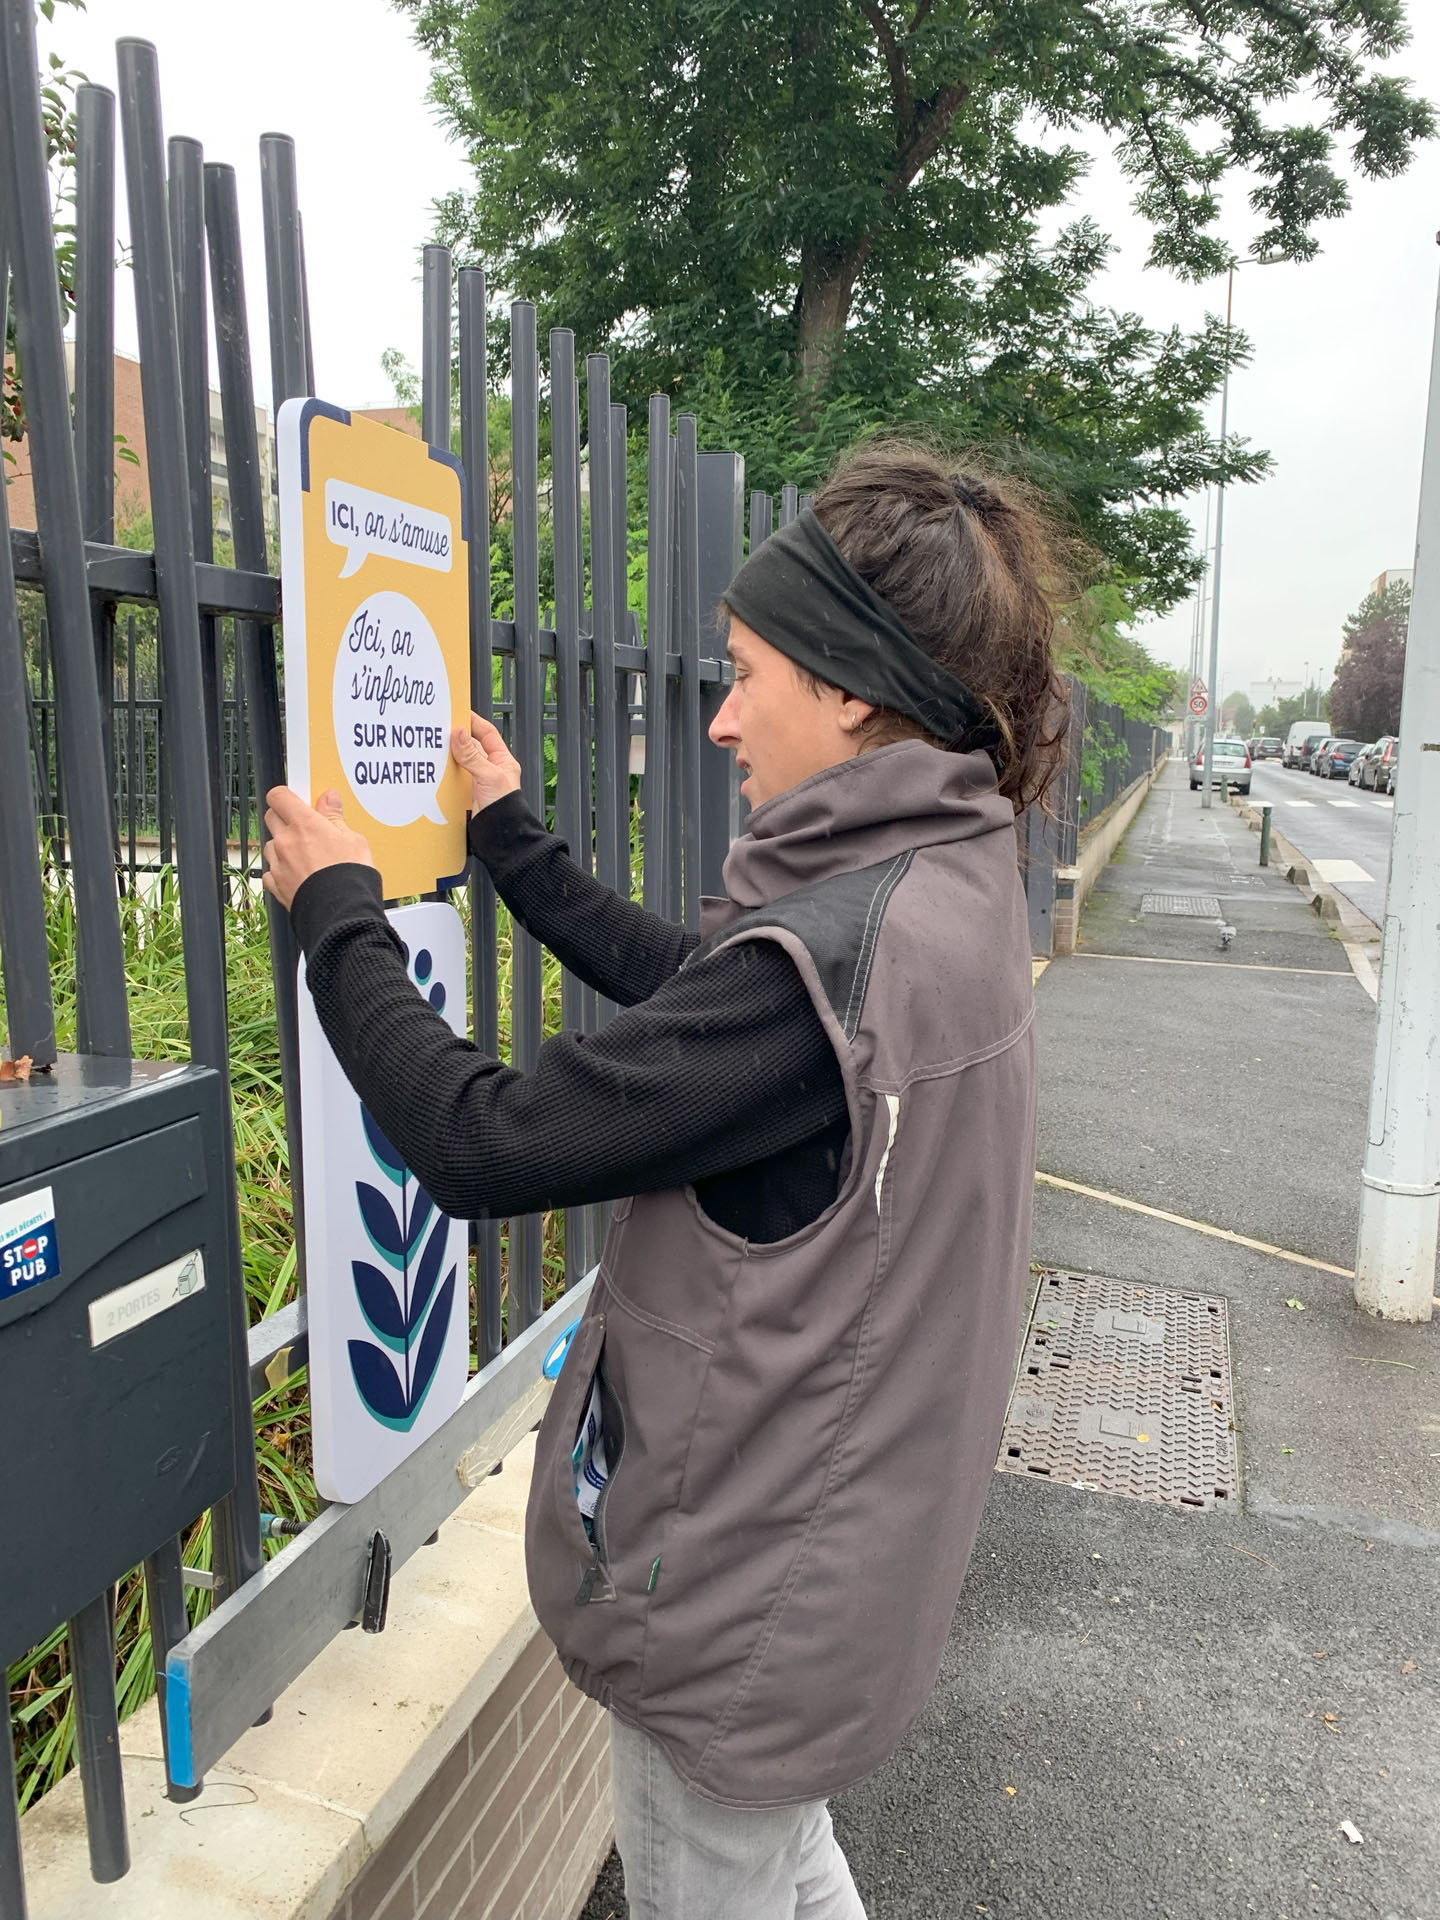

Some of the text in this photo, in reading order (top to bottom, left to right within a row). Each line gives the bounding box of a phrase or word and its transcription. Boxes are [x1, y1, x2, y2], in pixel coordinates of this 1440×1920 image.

[331, 500, 450, 557] ICI, on s'amuse
[348, 609, 415, 659] Ici, on
[351, 664, 436, 716] s'informe
[353, 722, 443, 749] SUR NOTRE
[354, 760, 436, 786] QUARTIER
[3, 1235, 49, 1268] STOP
[11, 1259, 47, 1286] PUB
[106, 1288, 160, 1327] 2 PORTES
